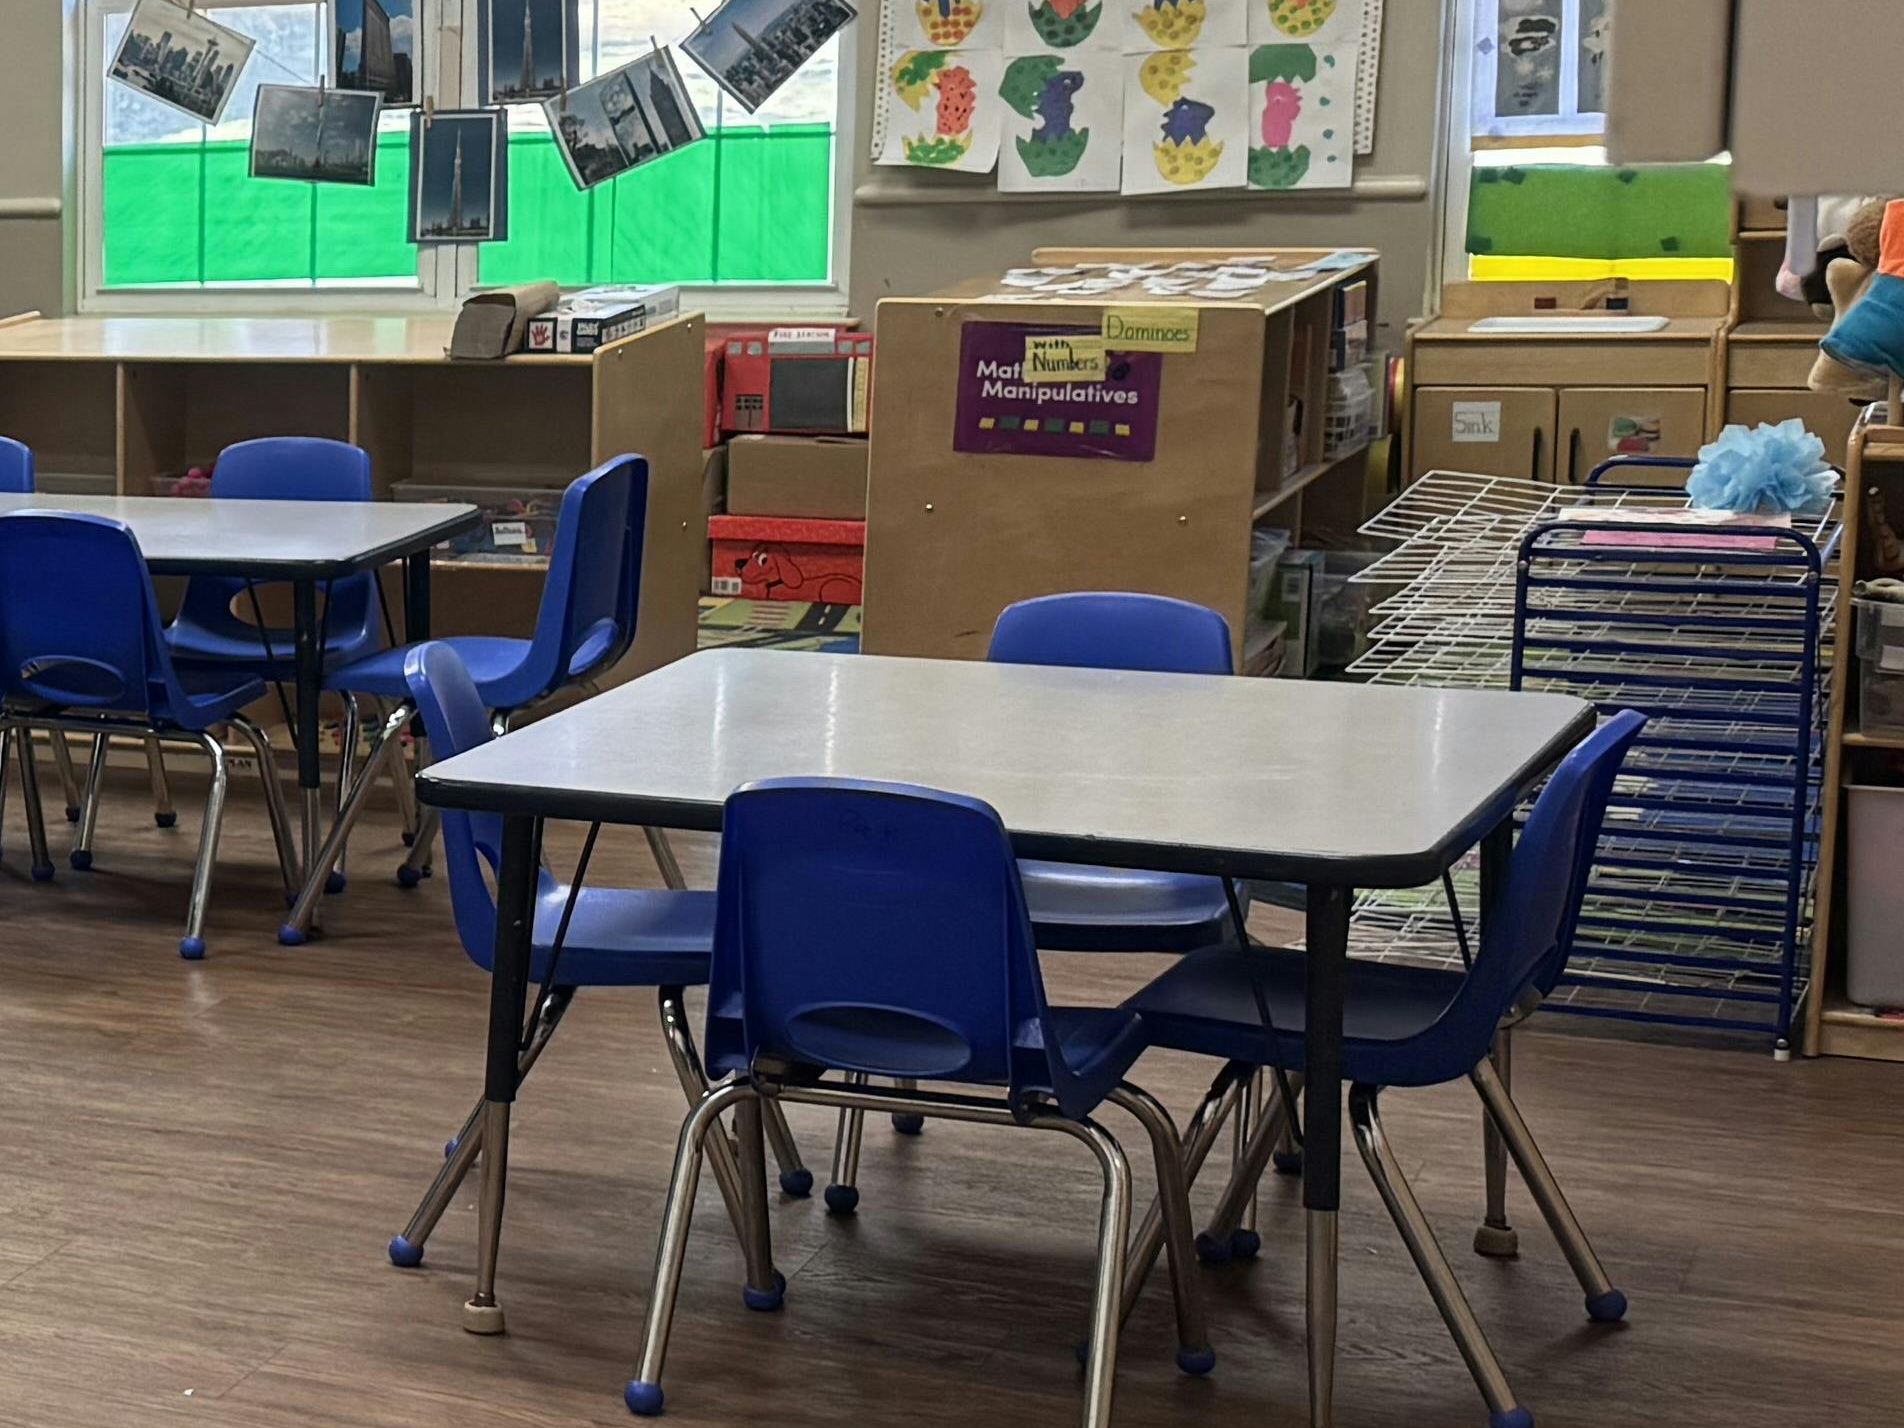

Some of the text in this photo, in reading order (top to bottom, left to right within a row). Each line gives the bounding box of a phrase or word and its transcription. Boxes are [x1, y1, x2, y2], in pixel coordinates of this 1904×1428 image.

[1106, 315, 1190, 343] Dominoes
[1032, 344, 1099, 374] Numbers
[981, 379, 1139, 405] Manipulatives
[1453, 410, 1495, 436] Sink
